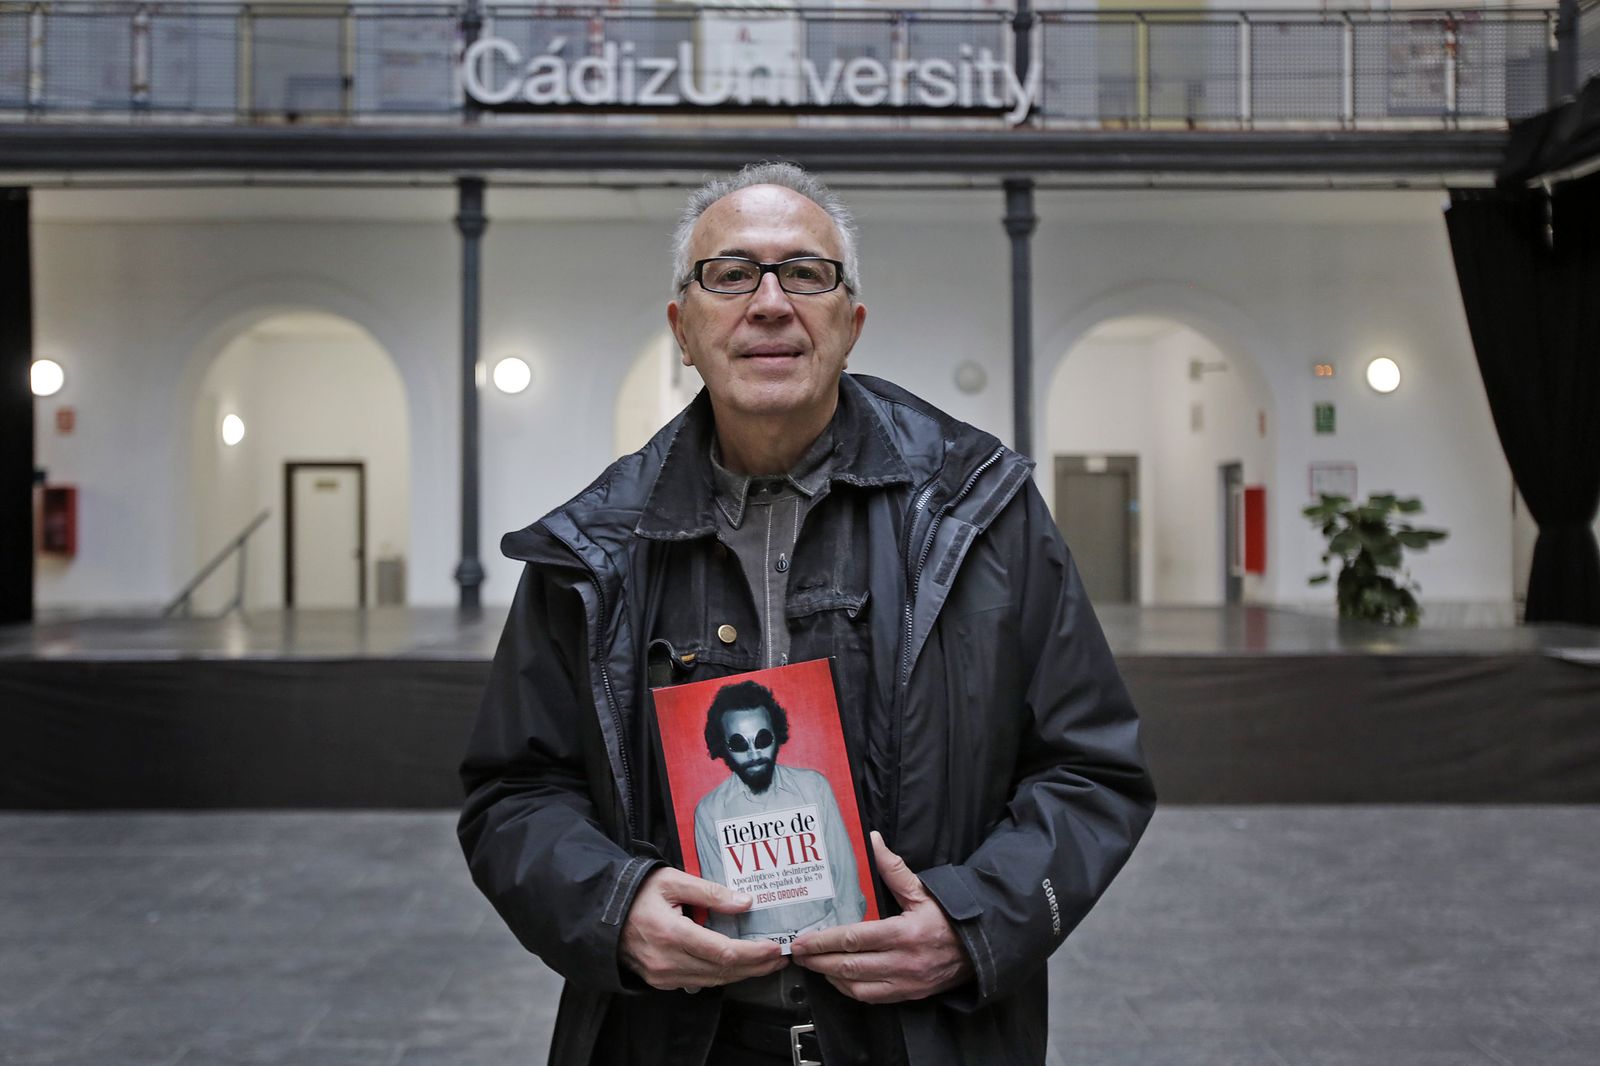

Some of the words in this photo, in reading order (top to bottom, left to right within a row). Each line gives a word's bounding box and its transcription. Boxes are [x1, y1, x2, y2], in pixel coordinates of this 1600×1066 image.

[723, 821, 785, 845] fiebre
[790, 813, 816, 833] de
[725, 832, 822, 874] VIVIR
[745, 885, 753, 893] el
[754, 882, 768, 891] rock
[769, 879, 794, 889] español
[795, 876, 802, 884] de
[802, 874, 813, 882] los
[814, 872, 823, 881] 70
[782, 863, 825, 877] desintegrados
